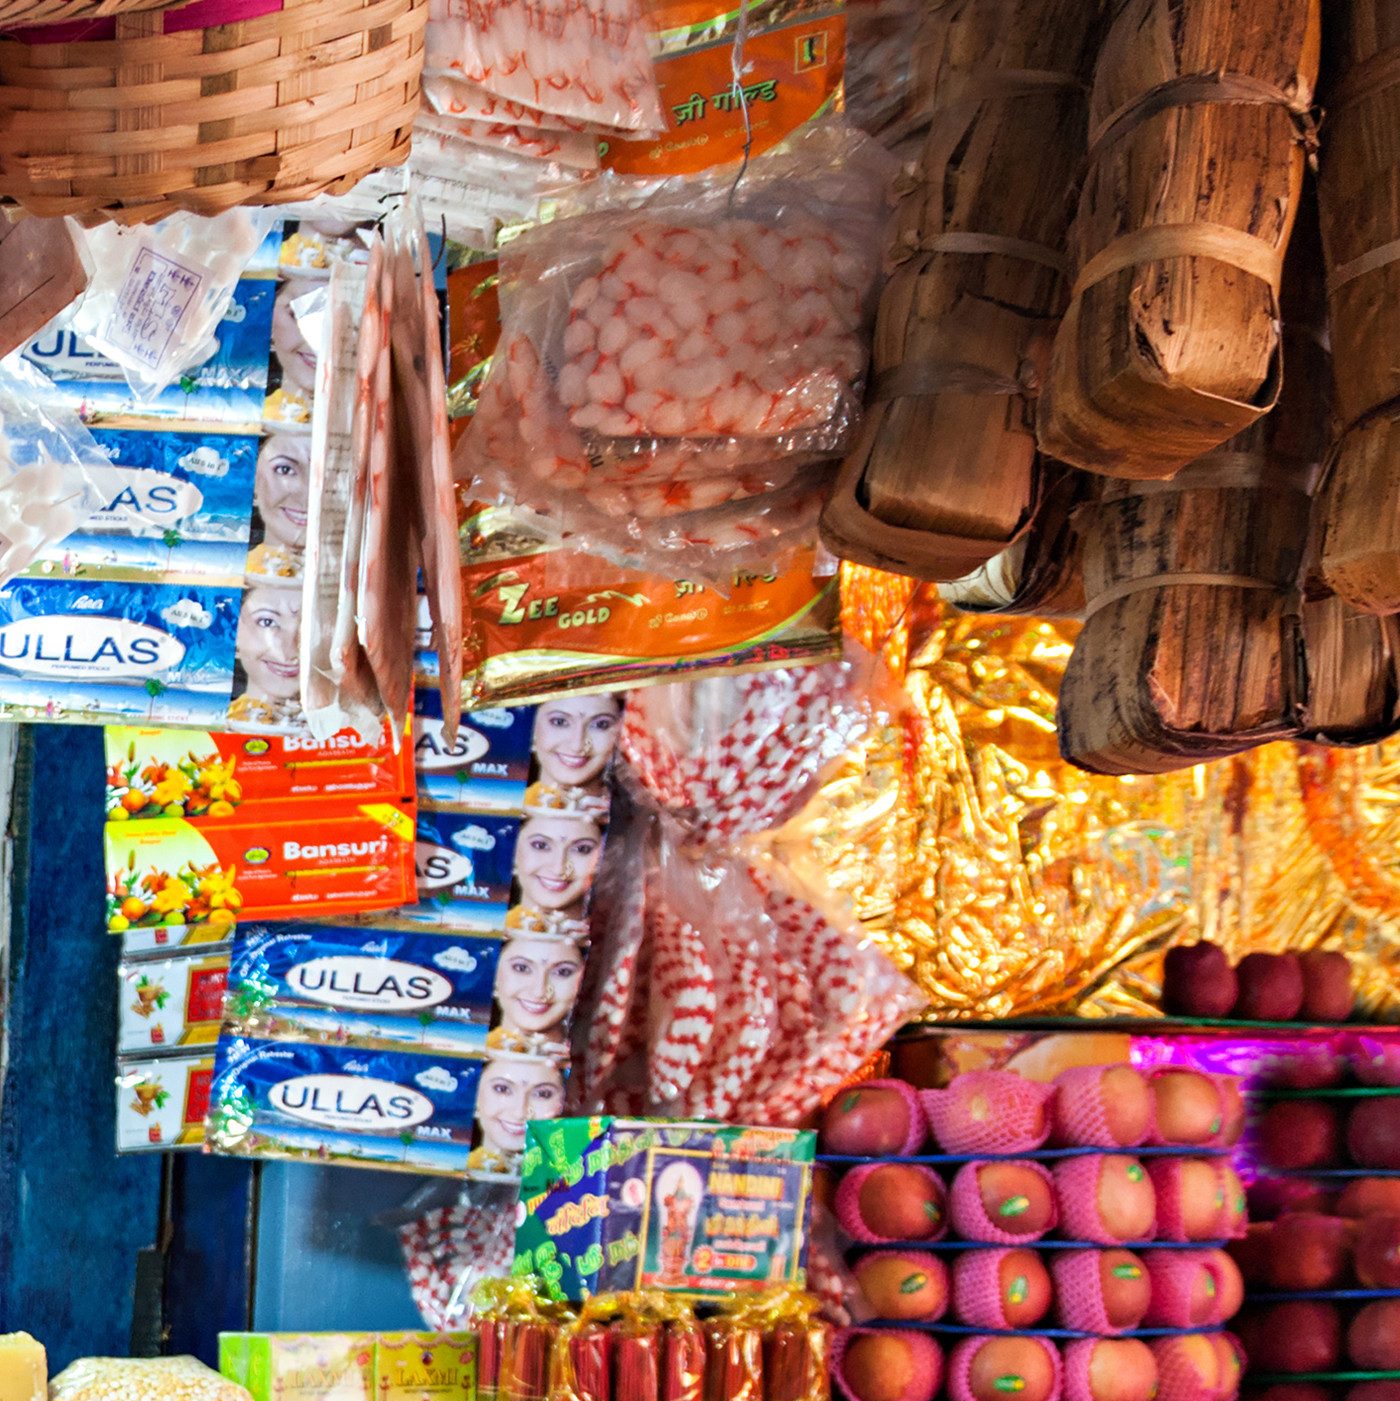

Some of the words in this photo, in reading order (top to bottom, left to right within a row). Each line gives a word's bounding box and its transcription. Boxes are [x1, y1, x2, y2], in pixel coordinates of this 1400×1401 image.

[499, 583, 559, 625] ZEE
[558, 607, 611, 630] GOLD
[0, 632, 160, 665] ULLAS
[472, 763, 508, 776] MAX
[283, 835, 388, 860] Bansuri
[454, 885, 489, 898] MAX
[300, 968, 433, 1000] ULLAS
[435, 1005, 471, 1019] MAX
[281, 1085, 414, 1119] ULLAS
[417, 1126, 451, 1138] MAX
[399, 1368, 458, 1386] LAXMI
